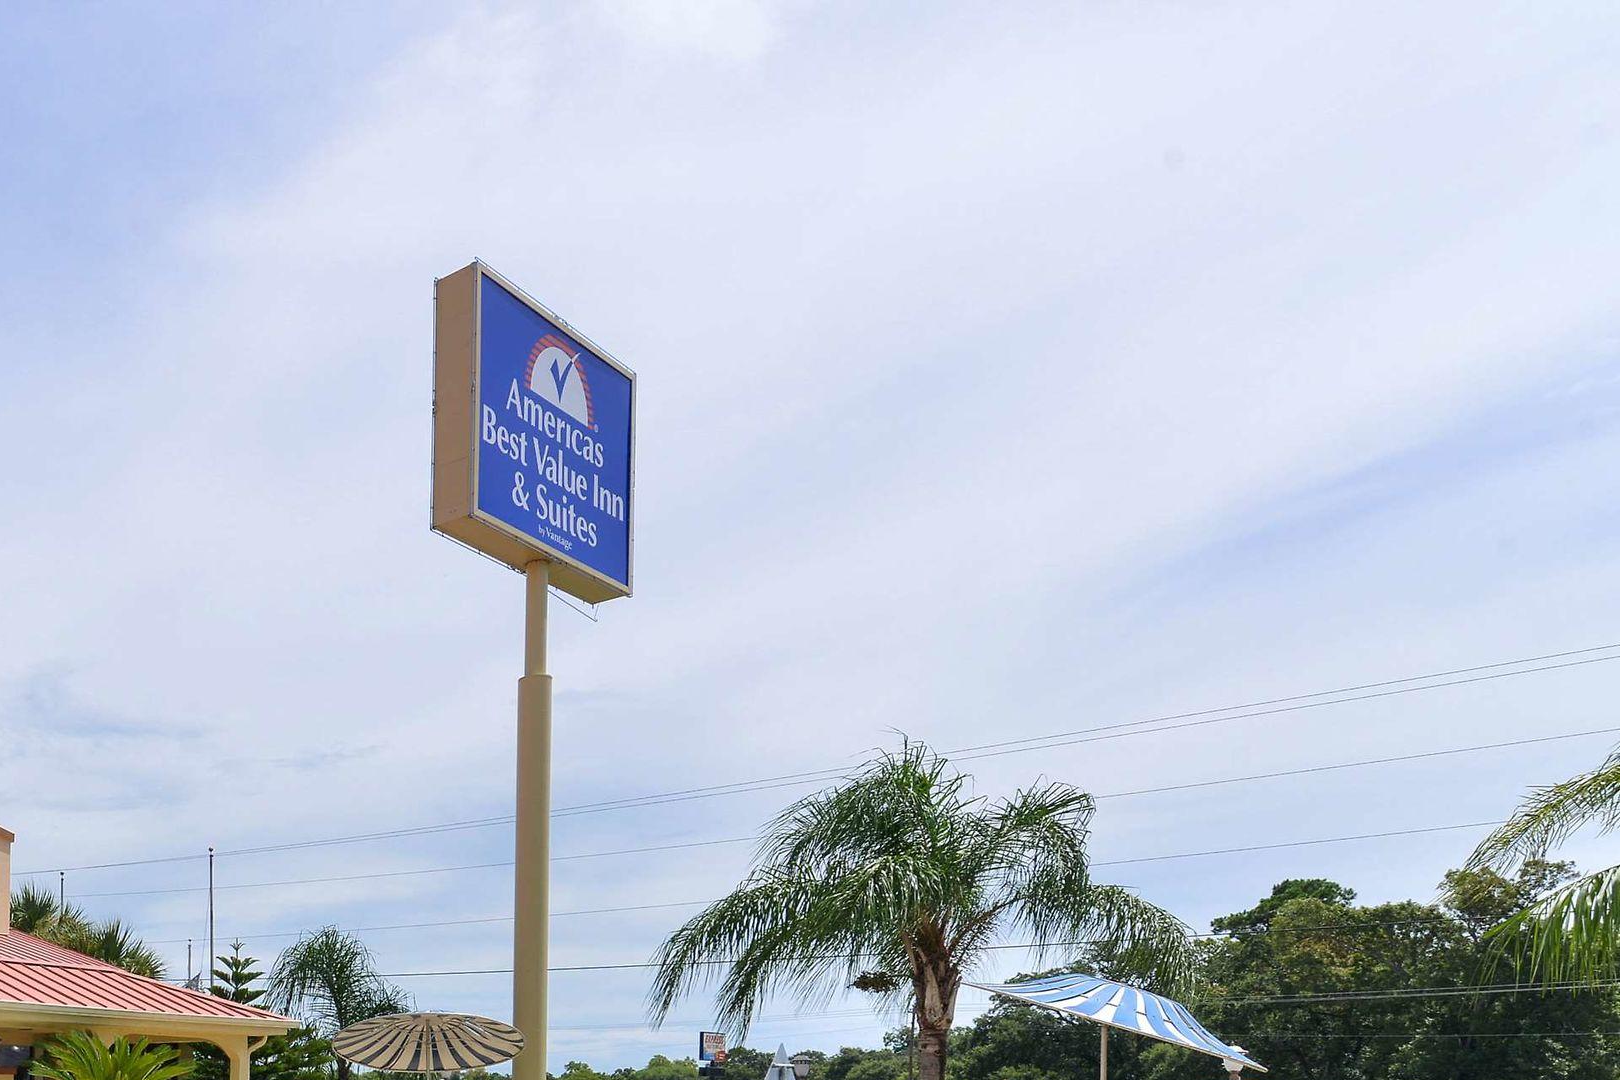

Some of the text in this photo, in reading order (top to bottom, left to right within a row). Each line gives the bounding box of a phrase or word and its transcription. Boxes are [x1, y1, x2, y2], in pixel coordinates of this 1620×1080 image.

[482, 404, 625, 522] Best Value Inn
[506, 378, 604, 468] Americas
[511, 471, 598, 548] & Suites
